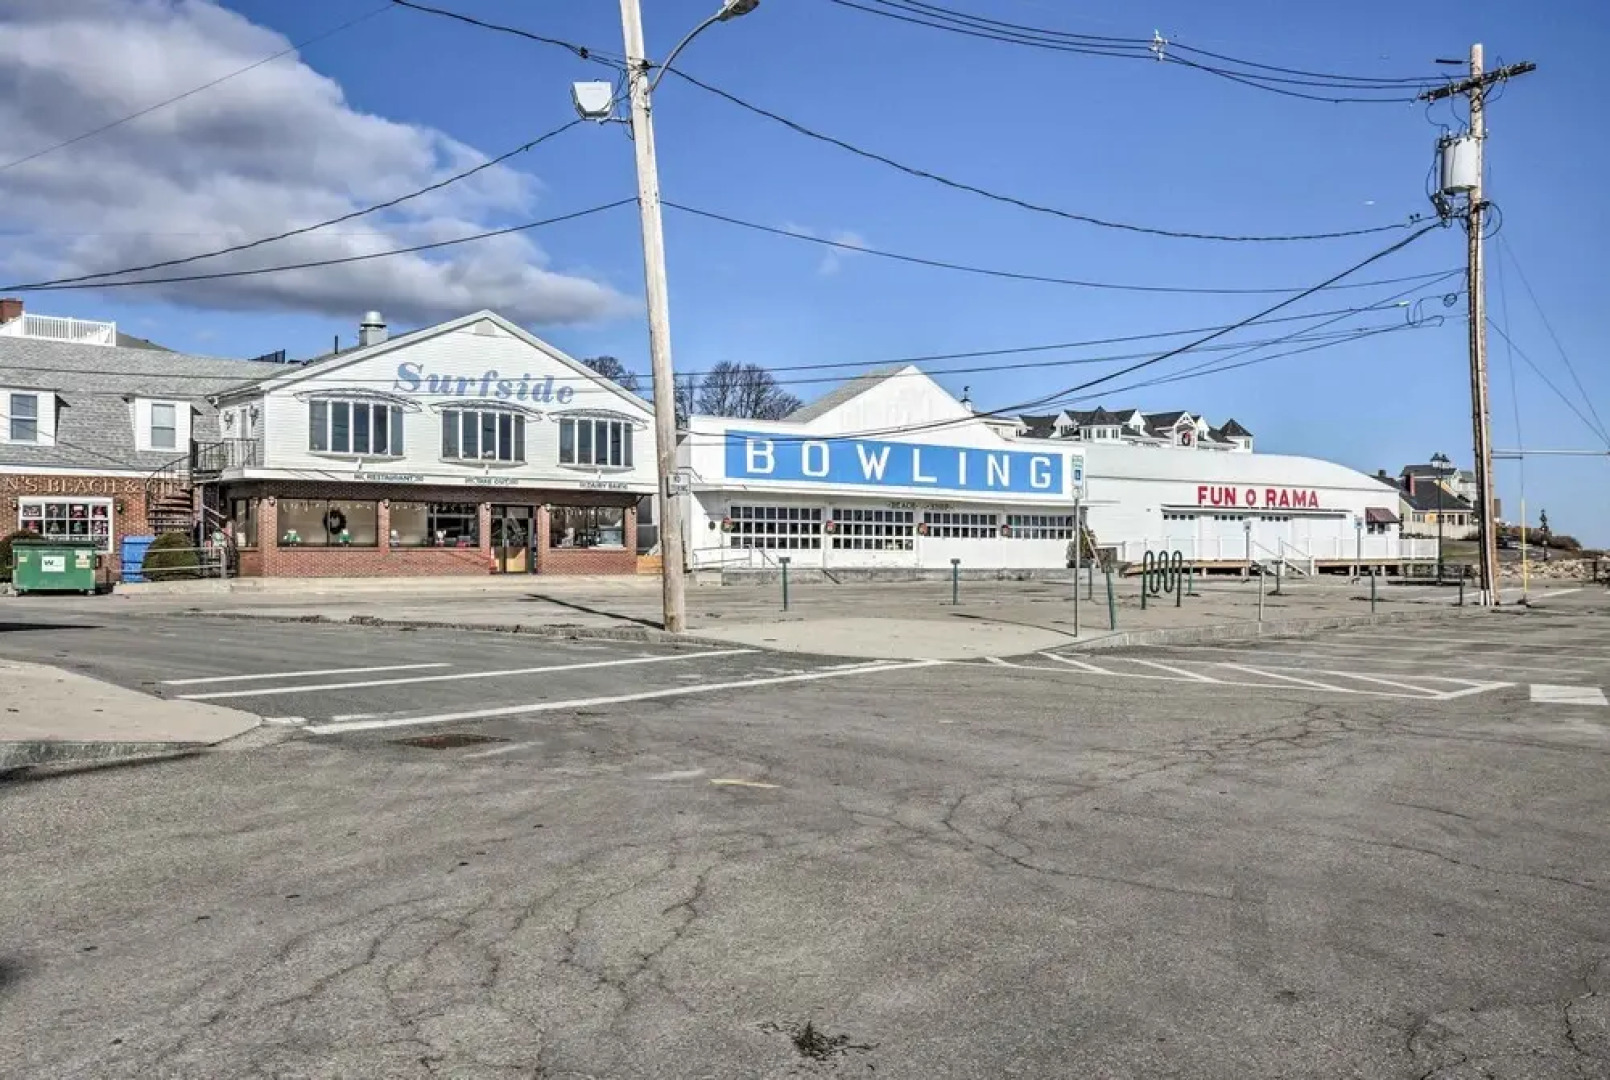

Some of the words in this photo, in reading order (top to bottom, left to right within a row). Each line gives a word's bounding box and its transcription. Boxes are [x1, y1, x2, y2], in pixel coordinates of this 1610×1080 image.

[393, 361, 574, 405] Surfside
[746, 438, 1052, 489] BOWLING
[47, 478, 117, 494] BEACH
[1197, 485, 1237, 507] FUN
[1245, 488, 1257, 507] O
[1265, 488, 1320, 508] RAMA
